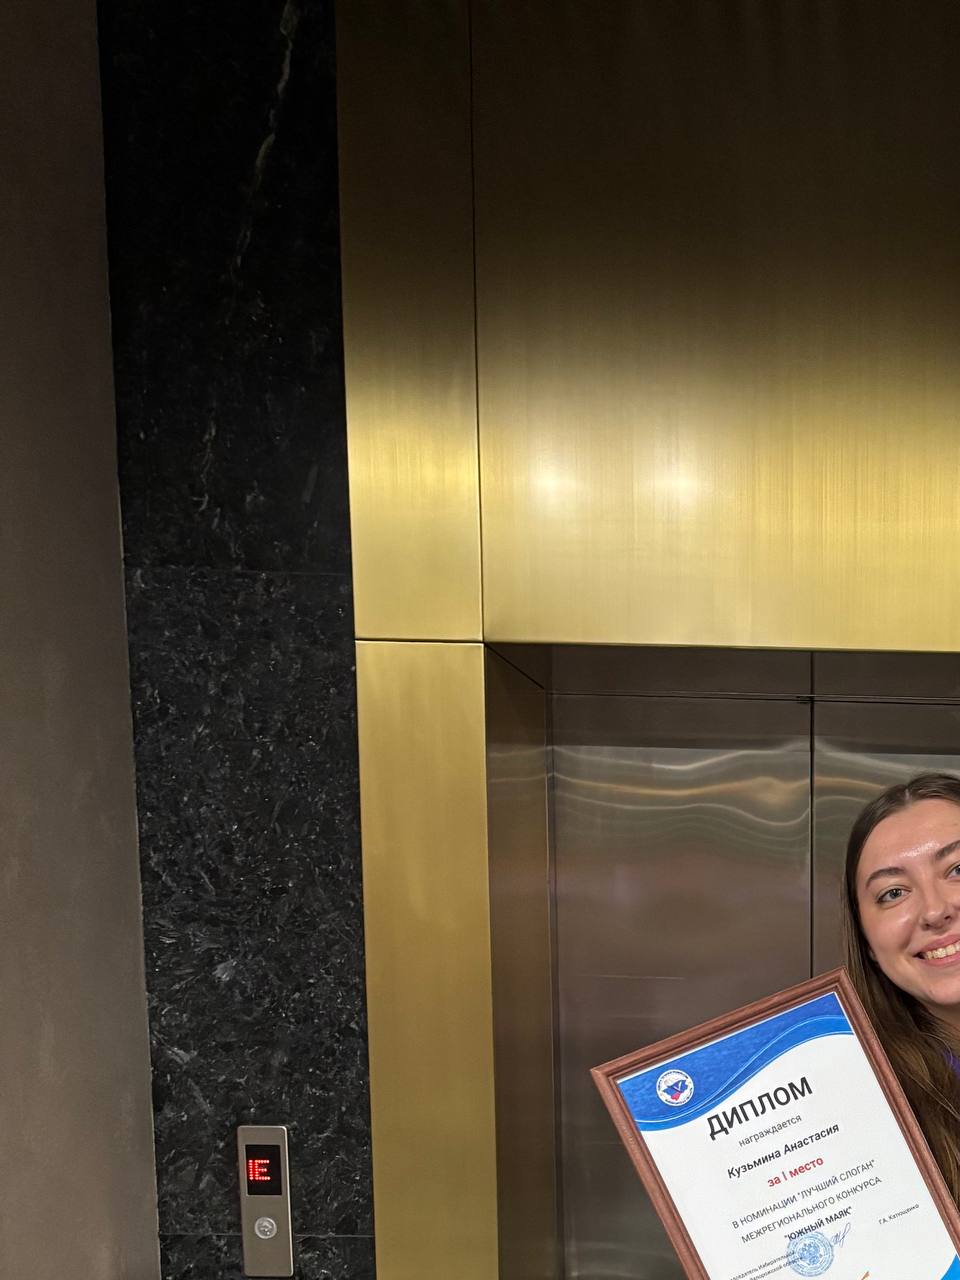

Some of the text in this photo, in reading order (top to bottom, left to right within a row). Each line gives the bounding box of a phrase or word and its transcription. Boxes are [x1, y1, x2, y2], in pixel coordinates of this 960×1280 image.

[707, 1076, 813, 1141] ДИПЛОМ
[738, 1114, 802, 1148] награждается
[727, 1123, 840, 1180] Кузьмина Анастасия
[767, 1176, 781, 1188] за
[789, 1157, 824, 1178] место
[732, 1159, 876, 1230] В НОМИНАЦИИ "ЛУЧШИЙ СЛОГАН"
[741, 1196, 836, 1244] МЕЖРЕГИОНАЛЬНОГО
[836, 1175, 882, 1202] КОНКУРСА
[784, 1217, 825, 1242] "ЮЖНЫЙ
[825, 1206, 853, 1226] МАЯК"
